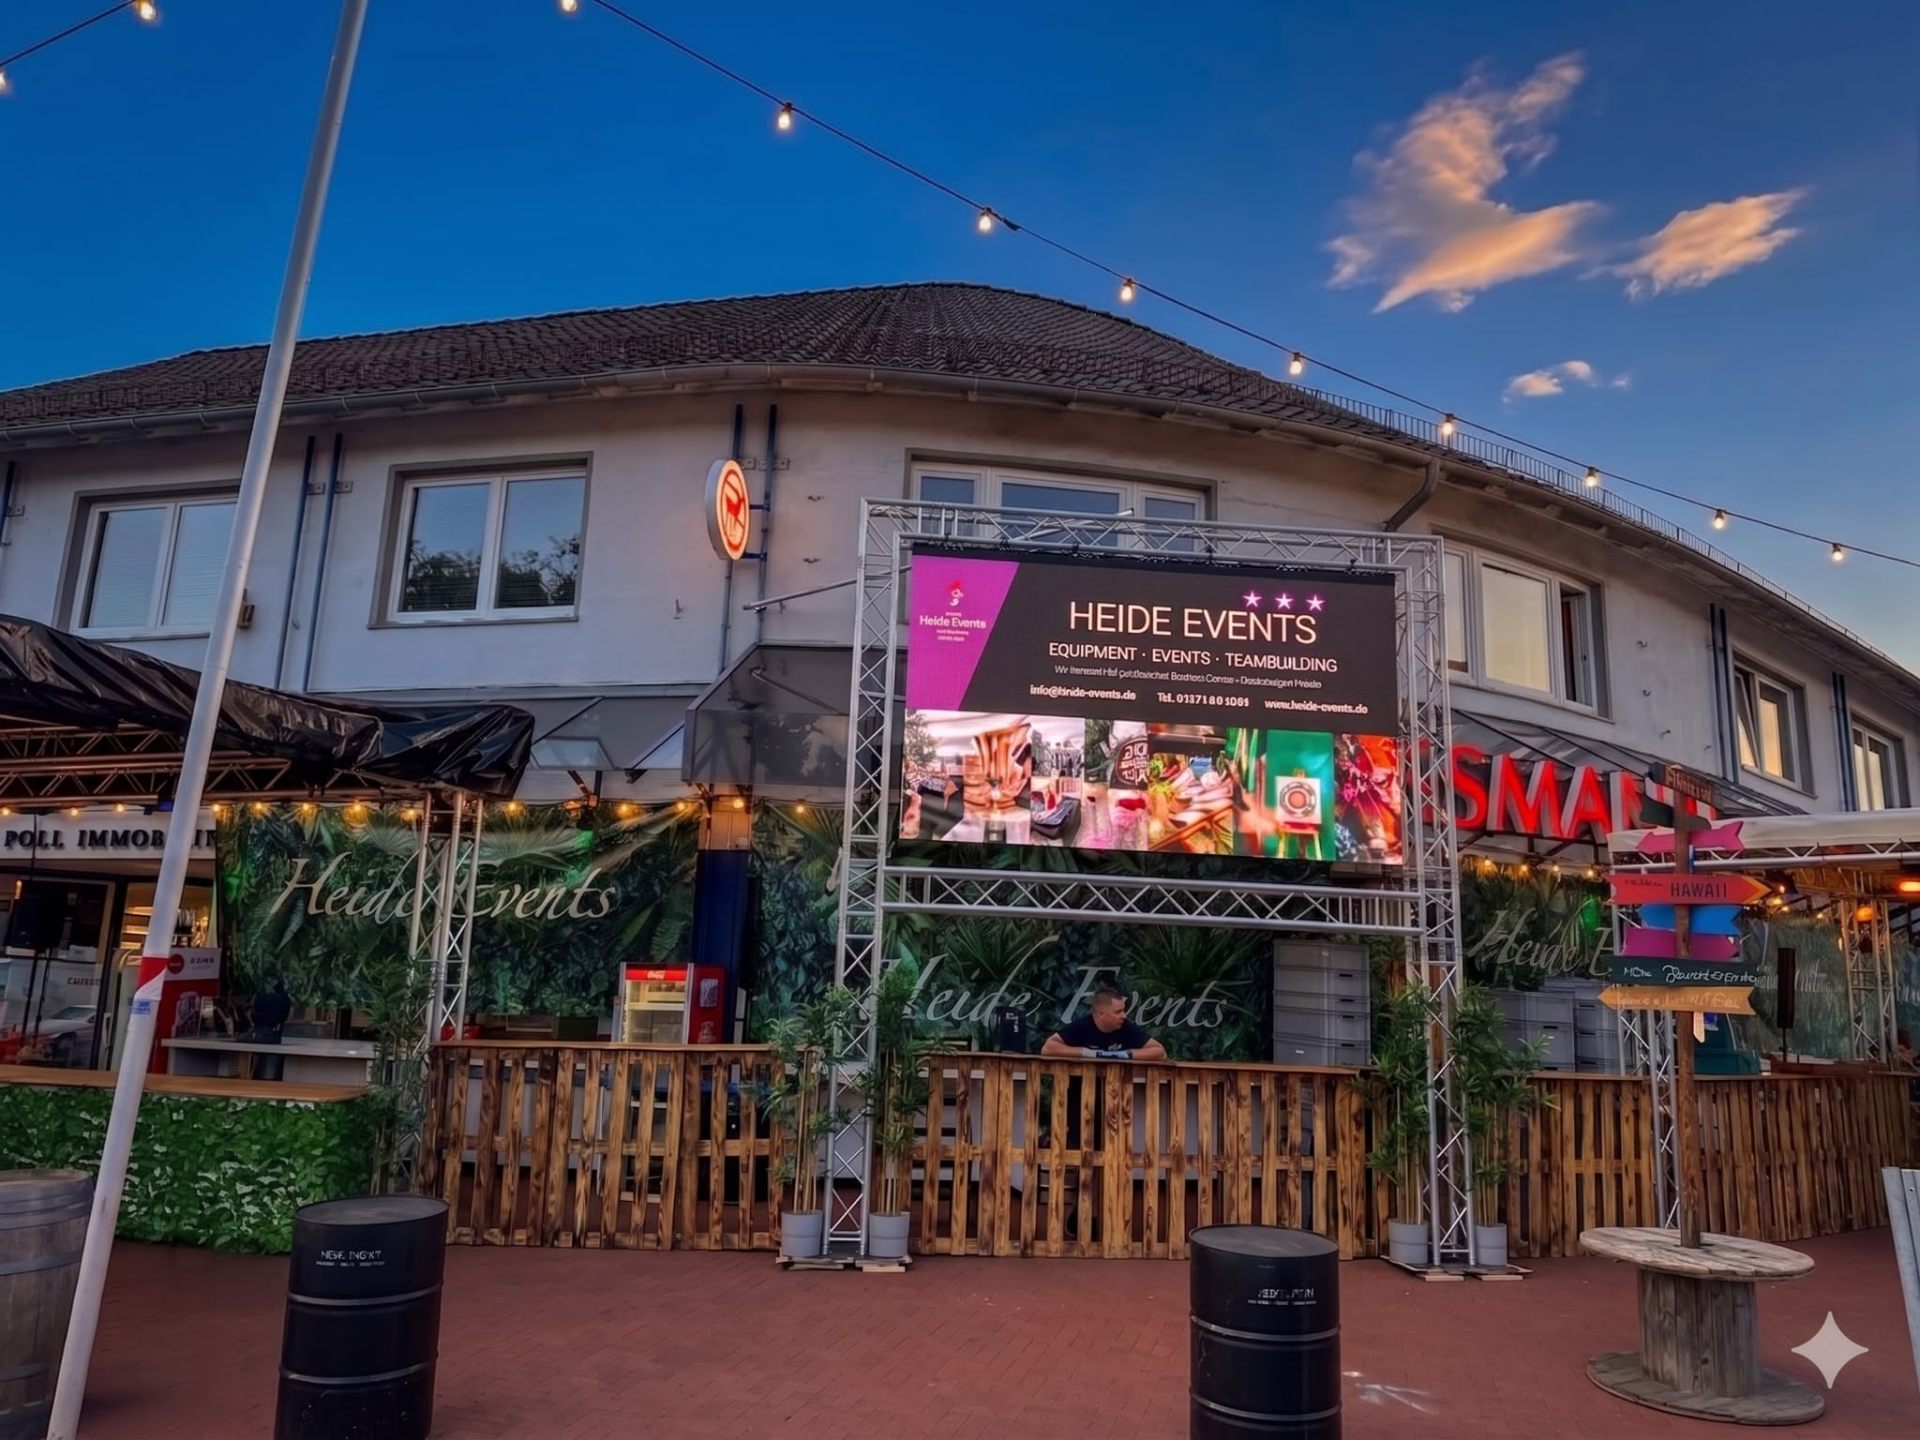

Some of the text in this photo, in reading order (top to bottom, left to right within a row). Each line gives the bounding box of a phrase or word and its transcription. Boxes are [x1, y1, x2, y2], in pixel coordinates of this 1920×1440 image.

[1069, 601, 1317, 644] HEIDE EVENTS
[1048, 642, 1338, 672] EQUIPMENT EVENTS TEAMBUILDING
[4, 829, 64, 848] POLL
[1670, 882, 1728, 899] HAWAII
